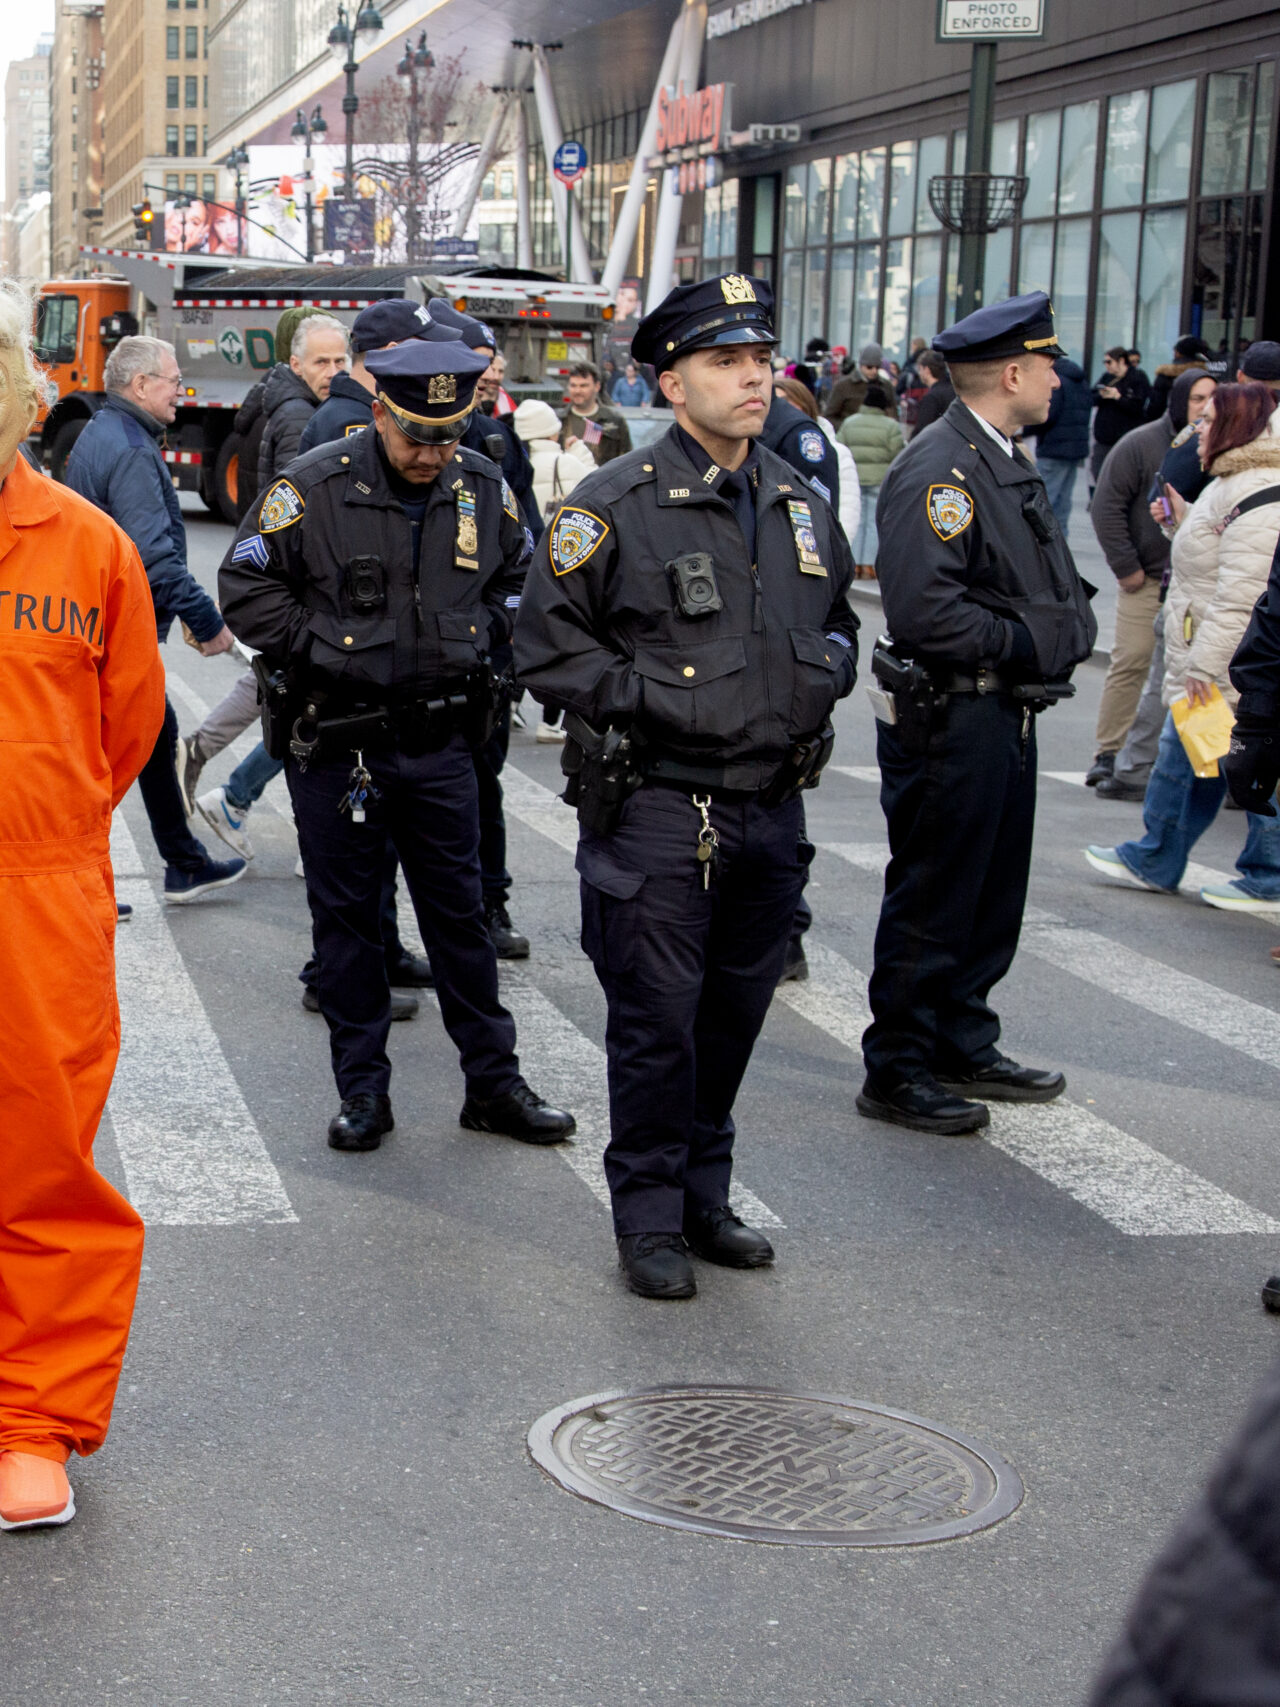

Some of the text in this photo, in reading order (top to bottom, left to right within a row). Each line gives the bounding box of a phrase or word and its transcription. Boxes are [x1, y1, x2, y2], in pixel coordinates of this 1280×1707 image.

[968, 3, 1017, 14] PHOTO
[952, 17, 1032, 29] ENFORCED
[656, 80, 725, 153] Subway
[571, 512, 596, 528] POLICE
[559, 517, 599, 540] DEPARTMENT
[553, 550, 559, 561] OF
[564, 542, 595, 569] NEW YORK
